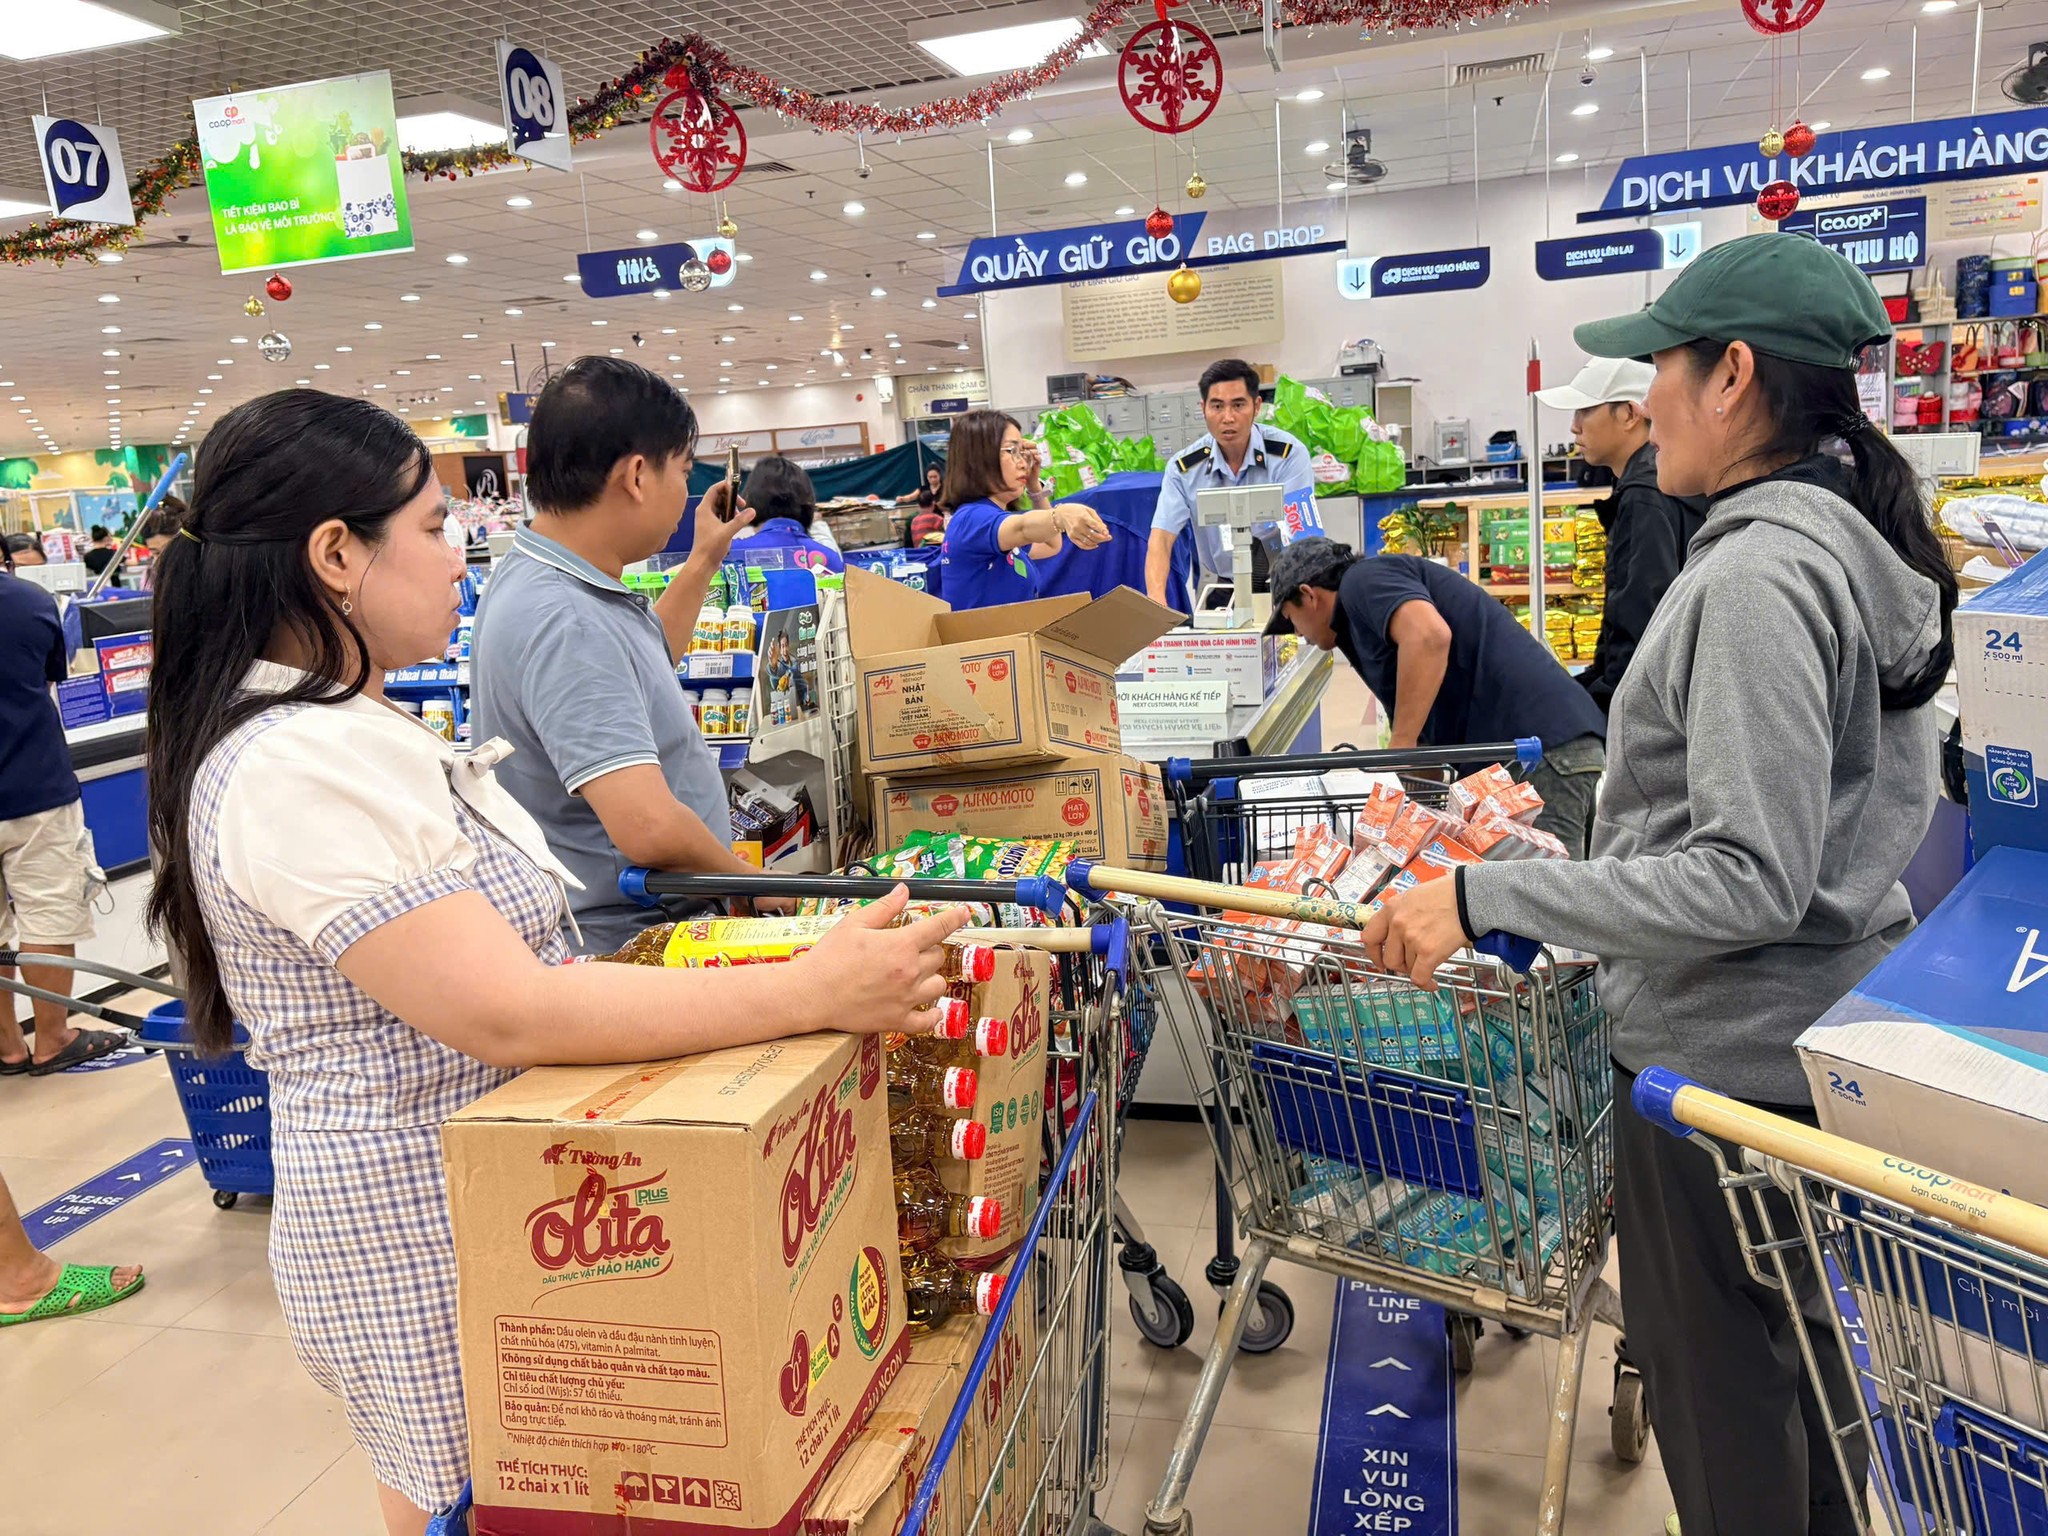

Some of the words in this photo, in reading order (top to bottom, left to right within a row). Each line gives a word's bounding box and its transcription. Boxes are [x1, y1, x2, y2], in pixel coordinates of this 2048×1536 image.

[510, 67, 553, 128] 08
[51, 138, 101, 187] 07
[1622, 167, 1711, 211] DỊCH
[1790, 140, 1926, 187] KHÁCH
[269, 199, 288, 212] BAO
[971, 238, 1050, 284] QUẦY
[1058, 235, 1114, 274] GIỮ
[1207, 232, 1257, 257] BAG
[1264, 225, 1325, 251] DROP
[1842, 239, 1884, 264] THU
[1889, 231, 1919, 263] HỘ
[1402, 267, 1422, 277] DỊCH
[1422, 265, 1434, 274] VỤ
[1434, 263, 1455, 274] GIAO
[1456, 260, 1480, 272] HÀNG
[1283, 502, 1305, 537] 30K
[1164, 640, 1184, 648] THANH
[1184, 638, 1200, 647] TOÁN
[1212, 638, 1224, 646] CÁC
[1226, 638, 1240, 646] HÌNH
[1241, 637, 1256, 646] THỨC
[1985, 629, 2023, 652] 24
[1992, 651, 2010, 660] 500
[1131, 691, 1161, 702] KHÁCH
[1162, 690, 1189, 701] HÀNG
[1190, 689, 1202, 700] KẾ
[1203, 690, 1221, 700] TIẾP
[1262, 829, 1297, 841] Selec
[1827, 1071, 1864, 1098] 24
[54, 1204, 95, 1216] LINE
[60, 1194, 124, 1206] PLEASE
[1910, 1184, 1930, 1199] bạn
[1930, 1193, 1949, 1205] của
[1950, 1200, 1967, 1212] mọi
[1969, 1206, 1987, 1219] nhà
[42, 1214, 70, 1225] UP
[558, 1271, 579, 1283] THỰC
[597, 1260, 623, 1276] HẢO
[625, 1257, 661, 1273] HẠNG
[834, 1299, 841, 1317] E
[861, 1291, 878, 1321] MAX
[1368, 1295, 1421, 1310] LINE
[1377, 1312, 1410, 1324] UP
[500, 1322, 528, 1334] Thành
[575, 1327, 597, 1338] olein
[598, 1329, 608, 1340] và
[646, 1332, 668, 1345] nành
[669, 1334, 688, 1346] tinh
[500, 1334, 520, 1346] chất
[538, 1338, 555, 1348] hóa
[556, 1339, 580, 1350] (475),
[581, 1341, 613, 1353] vitamin
[614, 1344, 622, 1354] A
[623, 1344, 661, 1358] palmitat.
[501, 1352, 532, 1366] Không
[532, 1354, 545, 1365] sử
[546, 1356, 569, 1368] dụng
[570, 1356, 590, 1368] chất
[591, 1359, 609, 1370] bảo
[610, 1361, 634, 1374] quản
[634, 1363, 646, 1373] và
[648, 1364, 668, 1376] chất
[668, 1366, 685, 1378] tạo
[686, 1367, 710, 1378] màu.
[877, 1348, 904, 1394] NGON
[519, 1372, 537, 1382] tiêu
[538, 1372, 558, 1384] chất
[559, 1374, 586, 1388] lượng
[587, 1376, 604, 1388] chủ
[519, 1384, 530, 1394] số
[530, 1384, 545, 1396] iod
[504, 1400, 524, 1412] Bảo
[524, 1402, 550, 1415] quản:
[580, 1406, 597, 1417] khô
[598, 1408, 613, 1418] ráo
[614, 1408, 626, 1419] và
[626, 1410, 657, 1424] thoáng
[680, 1415, 704, 1427] tránh
[704, 1416, 722, 1428] ánh
[506, 1413, 528, 1426] nắng
[529, 1416, 547, 1427] trực
[548, 1416, 566, 1428] tiếp.
[536, 1436, 548, 1446] độ
[548, 1438, 570, 1448] chiên
[799, 1452, 810, 1470] 12
[809, 1433, 825, 1458] chai
[1362, 1447, 1409, 1466] XIN
[497, 1457, 520, 1474] THỂ
[520, 1460, 549, 1476] TÍCH
[550, 1464, 588, 1480] THỰC:
[1361, 1467, 1408, 1488] VUI
[499, 1476, 516, 1491] 12
[518, 1478, 548, 1493] chai
[551, 1484, 560, 1494] x
[562, 1481, 570, 1494] 1
[574, 1480, 590, 1496] lít
[1343, 1487, 1425, 1512] LÒNG
[1353, 1509, 1412, 1534] XẾP
